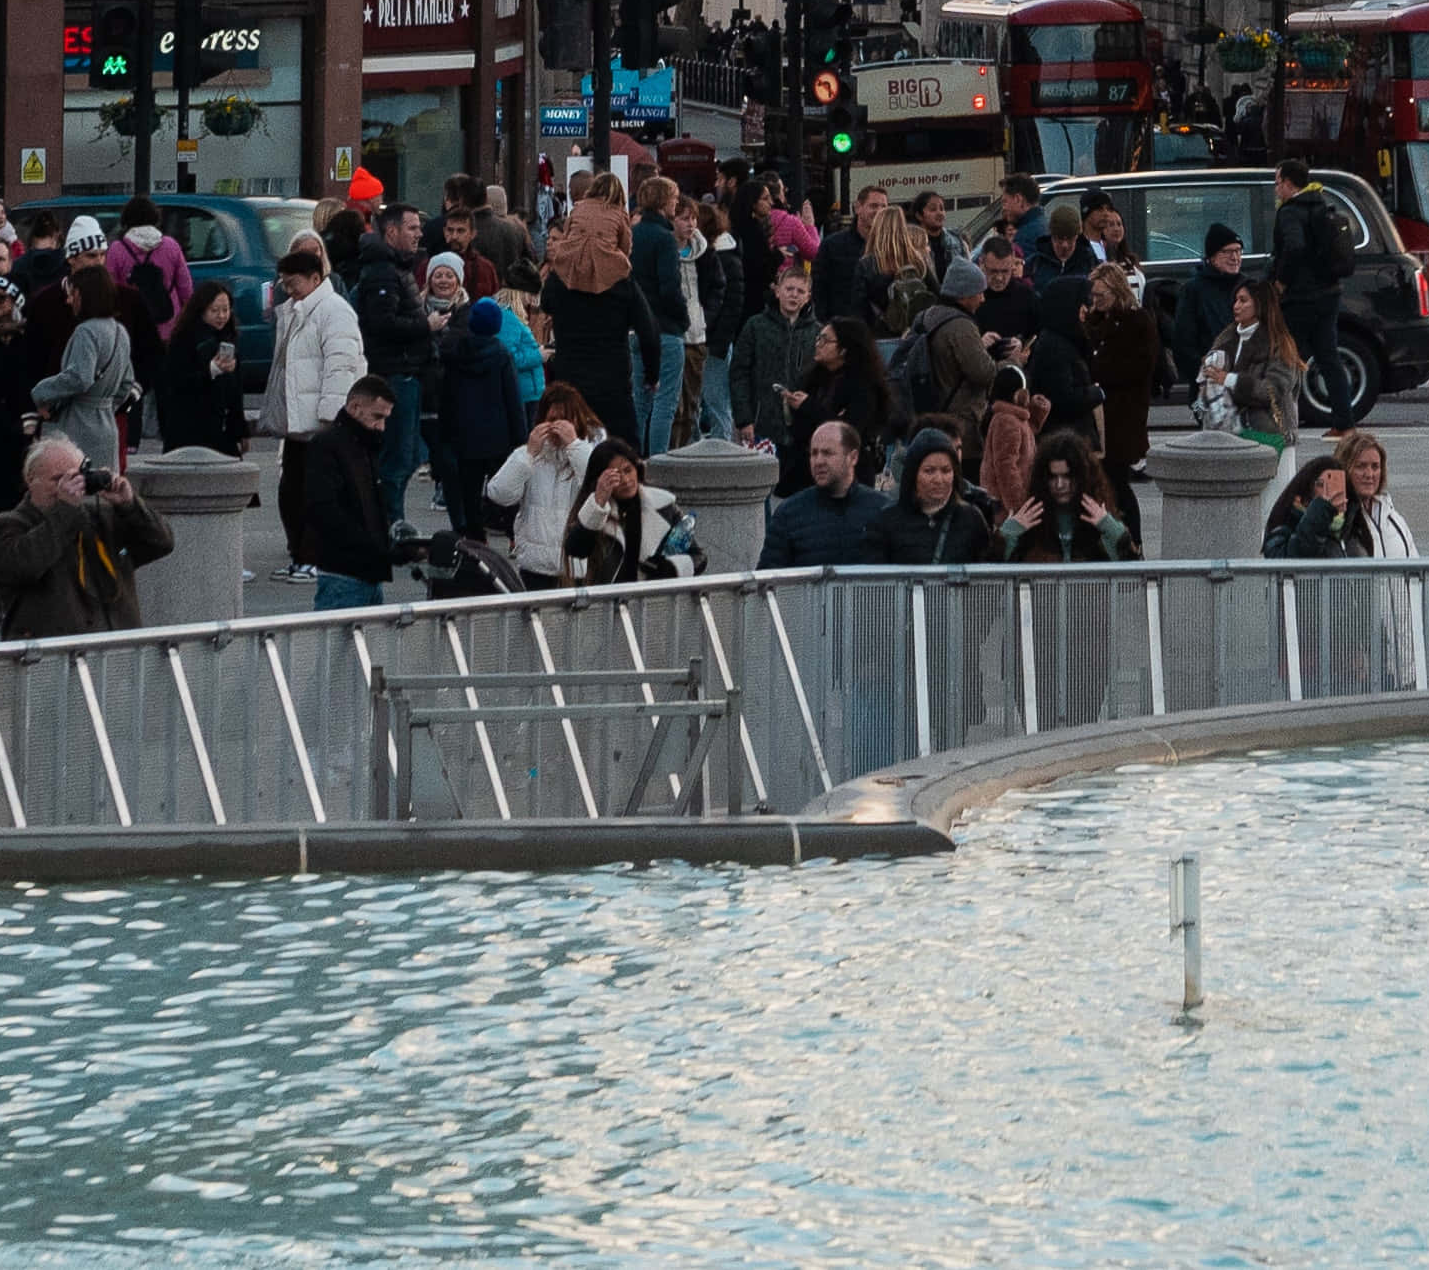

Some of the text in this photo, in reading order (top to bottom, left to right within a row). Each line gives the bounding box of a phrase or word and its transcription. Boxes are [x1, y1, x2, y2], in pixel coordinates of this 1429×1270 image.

[888, 79, 917, 95] BIG
[1108, 83, 1129, 101] 87
[889, 94, 919, 110] BUS
[544, 109, 583, 120] MONEY
[541, 124, 585, 136] CHANGE
[878, 174, 961, 188] HOP-ON HOP-OFF
